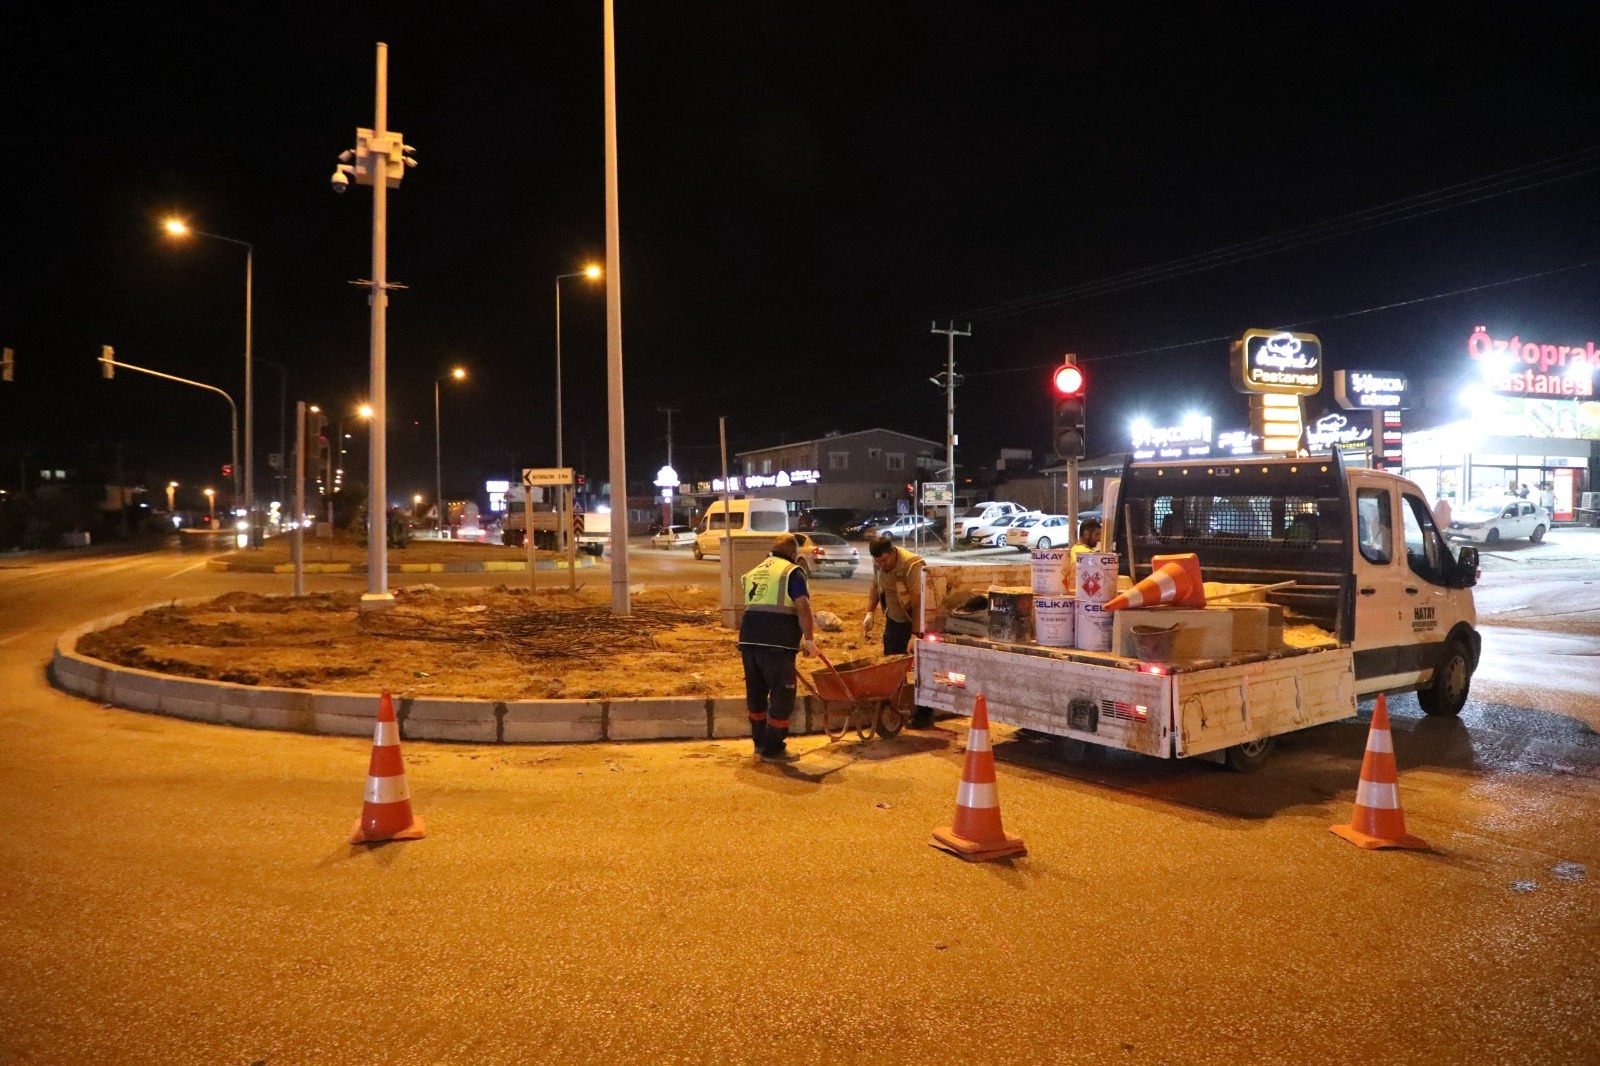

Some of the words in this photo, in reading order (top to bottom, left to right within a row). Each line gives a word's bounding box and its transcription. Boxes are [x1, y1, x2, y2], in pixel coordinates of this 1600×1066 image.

[1468, 325, 1600, 372] Öztoprak
[1483, 367, 1593, 396] astanesi
[1414, 606, 1436, 620] HATAY
